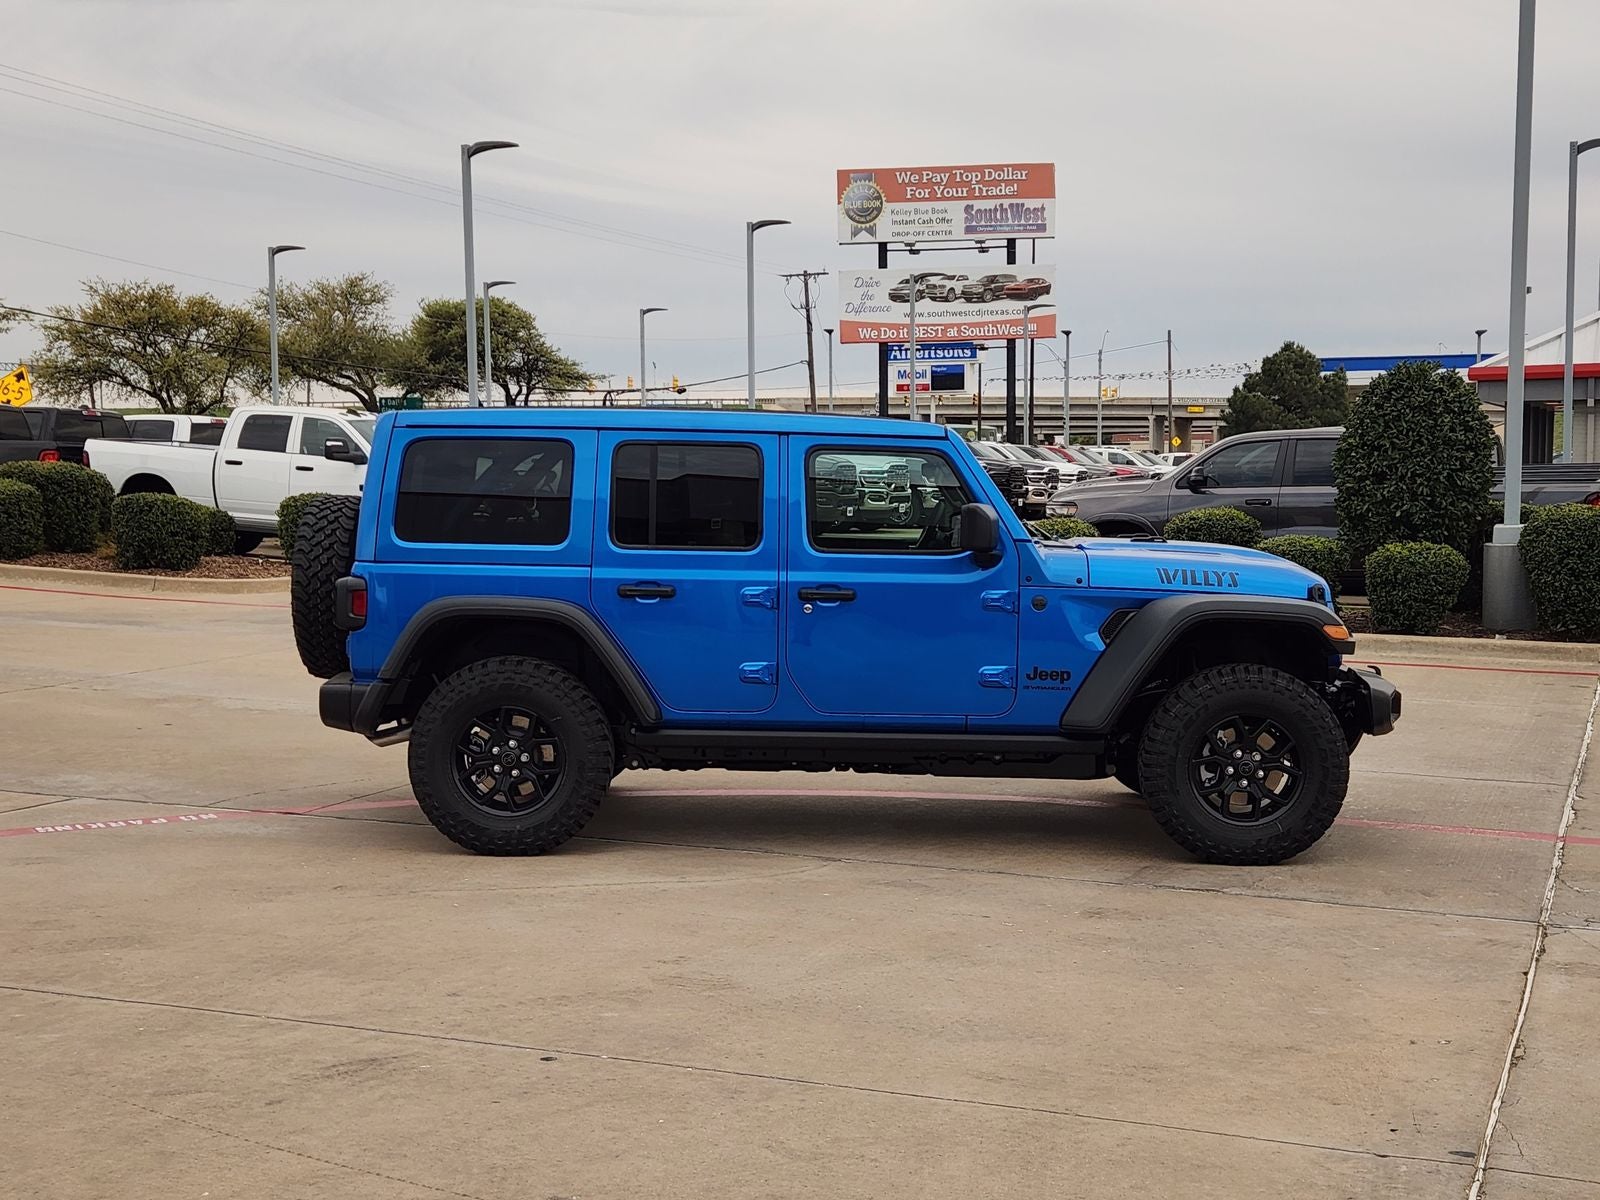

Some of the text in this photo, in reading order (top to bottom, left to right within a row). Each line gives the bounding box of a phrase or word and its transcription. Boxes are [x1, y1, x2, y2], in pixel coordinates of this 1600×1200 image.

[895, 167, 1028, 185] We Pay Top Dollar
[905, 183, 1018, 199] For Your Trade!
[844, 199, 882, 209] BLUE BOOK
[890, 207, 949, 217] Kelley Blue Book
[963, 202, 1047, 225] SouthWest
[891, 216, 953, 226] Instant Cash Offer
[927, 229, 953, 237] CENTER
[853, 276, 882, 288] Drive
[860, 289, 875, 301] the
[845, 302, 892, 316] Difference
[858, 327, 878, 339] We
[880, 327, 898, 339] Do
[899, 326, 909, 338] it
[947, 325, 958, 337] at
[960, 323, 1037, 337] SouthWes!!!
[1155, 567, 1240, 588] WILLYS
[1025, 666, 1072, 685] Jeep
[34, 812, 218, 833] NO PARKING
